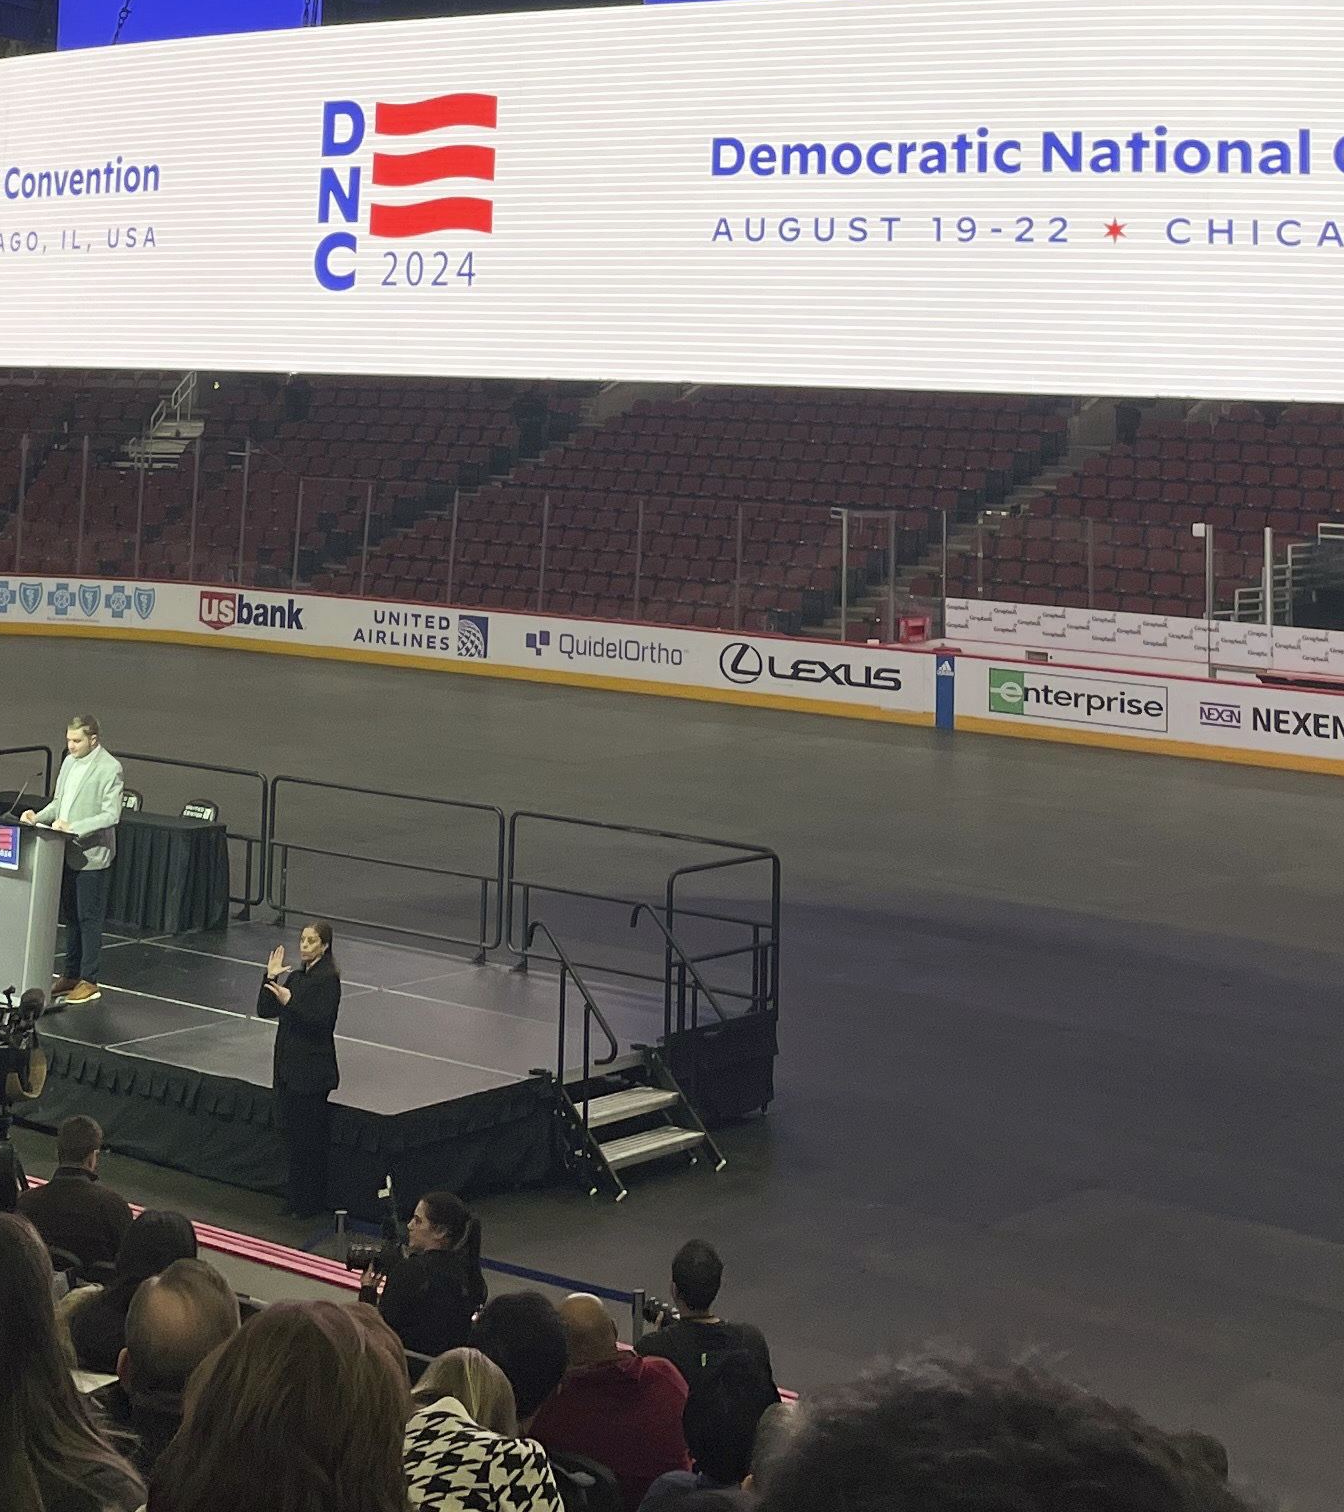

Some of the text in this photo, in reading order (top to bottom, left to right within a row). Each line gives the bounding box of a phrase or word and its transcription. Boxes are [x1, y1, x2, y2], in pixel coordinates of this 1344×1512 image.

[709, 125, 1024, 178] Democratic
[1041, 124, 1312, 175] National
[3, 155, 161, 202] Convention
[107, 226, 158, 250] USA
[711, 216, 903, 245] AUGUST
[930, 215, 1072, 245] 19-22
[379, 249, 477, 288] 2024
[372, 608, 452, 632] UNITED
[352, 627, 452, 652] AIRLINES
[558, 632, 684, 668] QuidelOrtho
[768, 658, 903, 692] LEXUS
[997, 678, 1166, 720] enterprise
